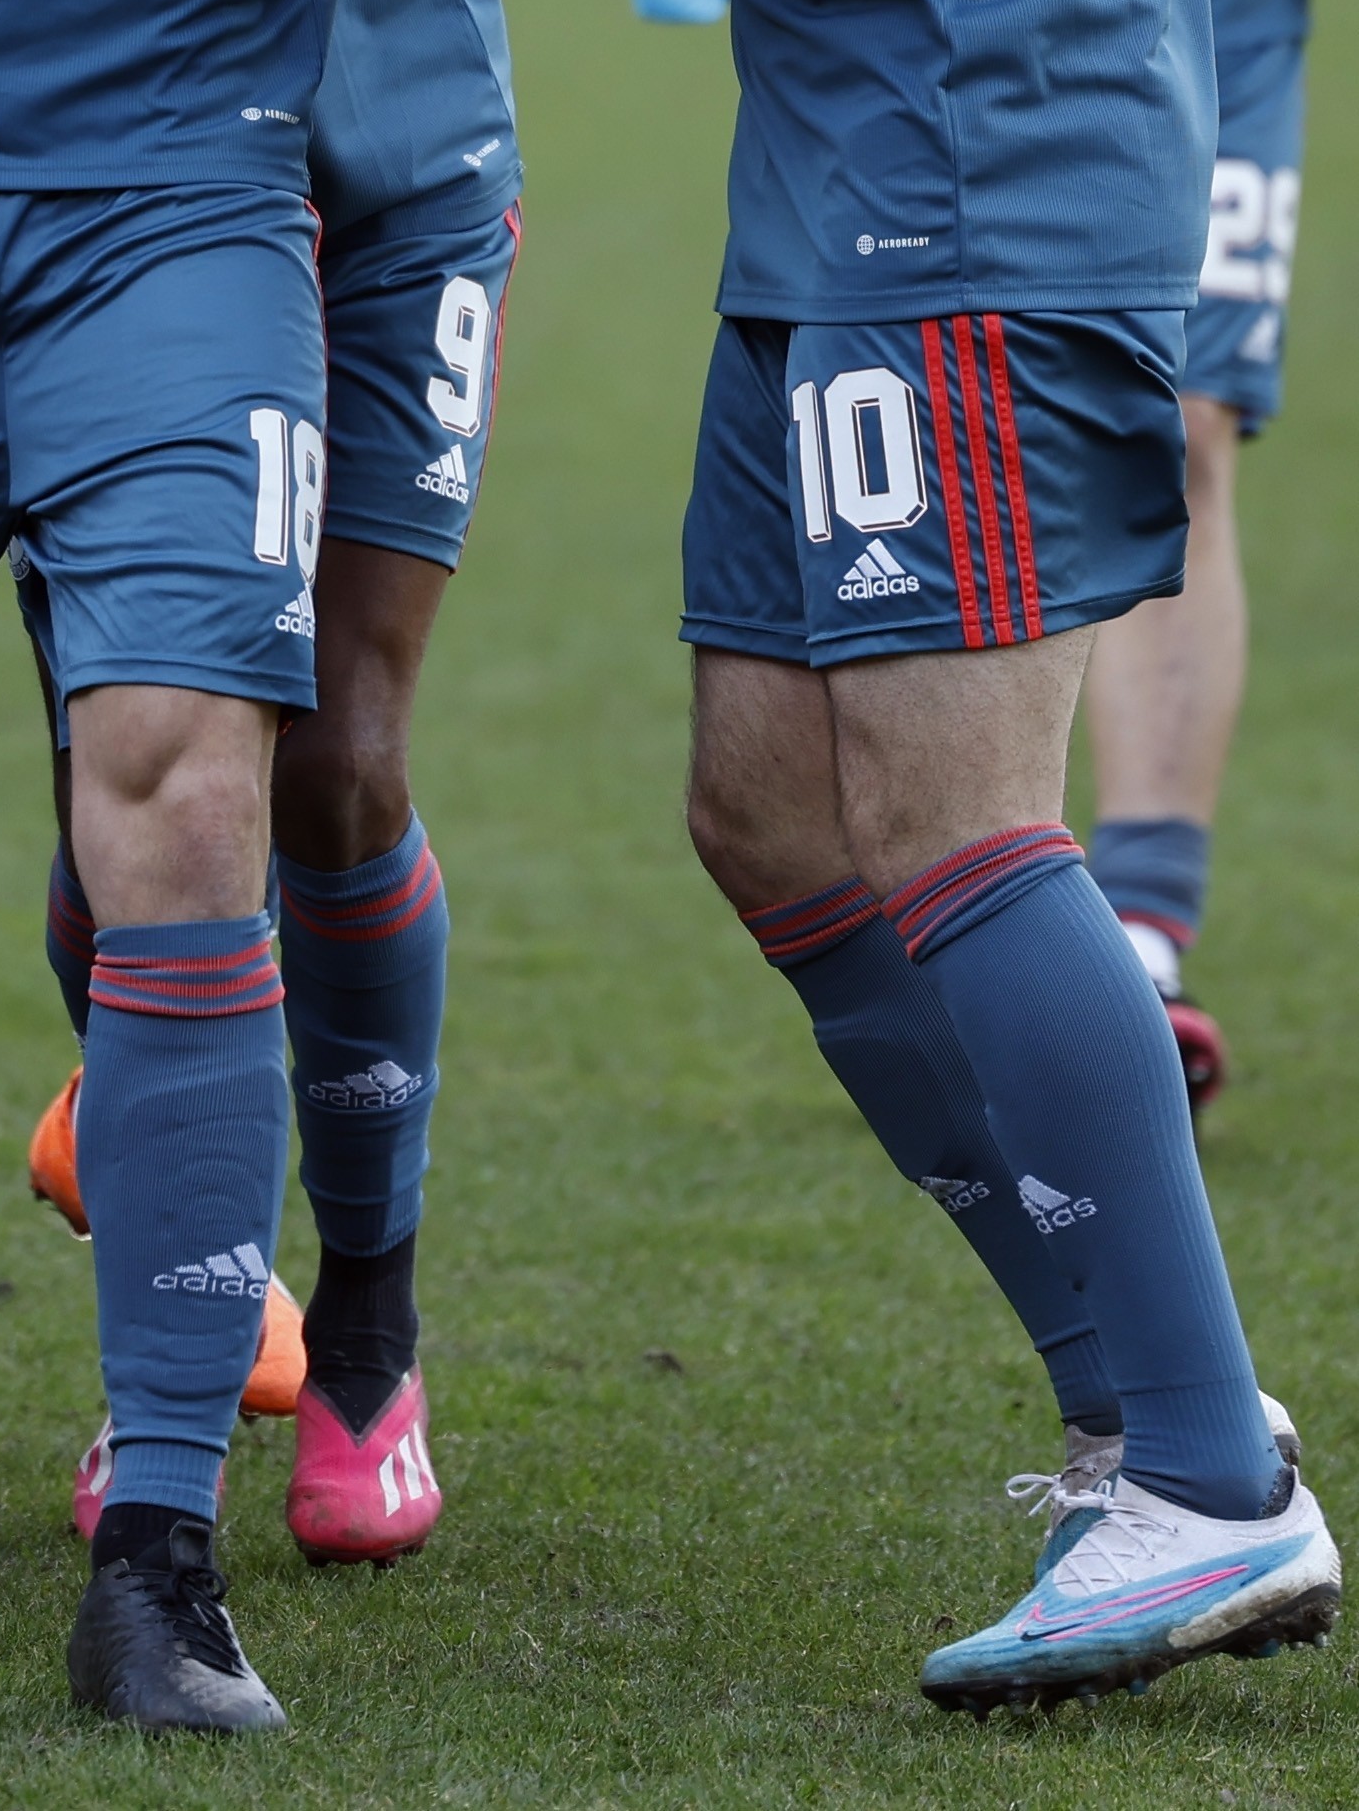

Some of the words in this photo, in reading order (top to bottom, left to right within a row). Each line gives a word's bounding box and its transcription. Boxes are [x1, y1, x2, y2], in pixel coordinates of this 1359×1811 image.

[878, 236, 930, 249] AEROREADY
[426, 275, 492, 438] 9
[791, 367, 929, 544] 10
[250, 407, 326, 589] 18
[415, 469, 470, 505] adidas
[837, 575, 920, 601] adidas
[308, 1074, 422, 1108] adidas
[152, 1271, 270, 1300] adida
